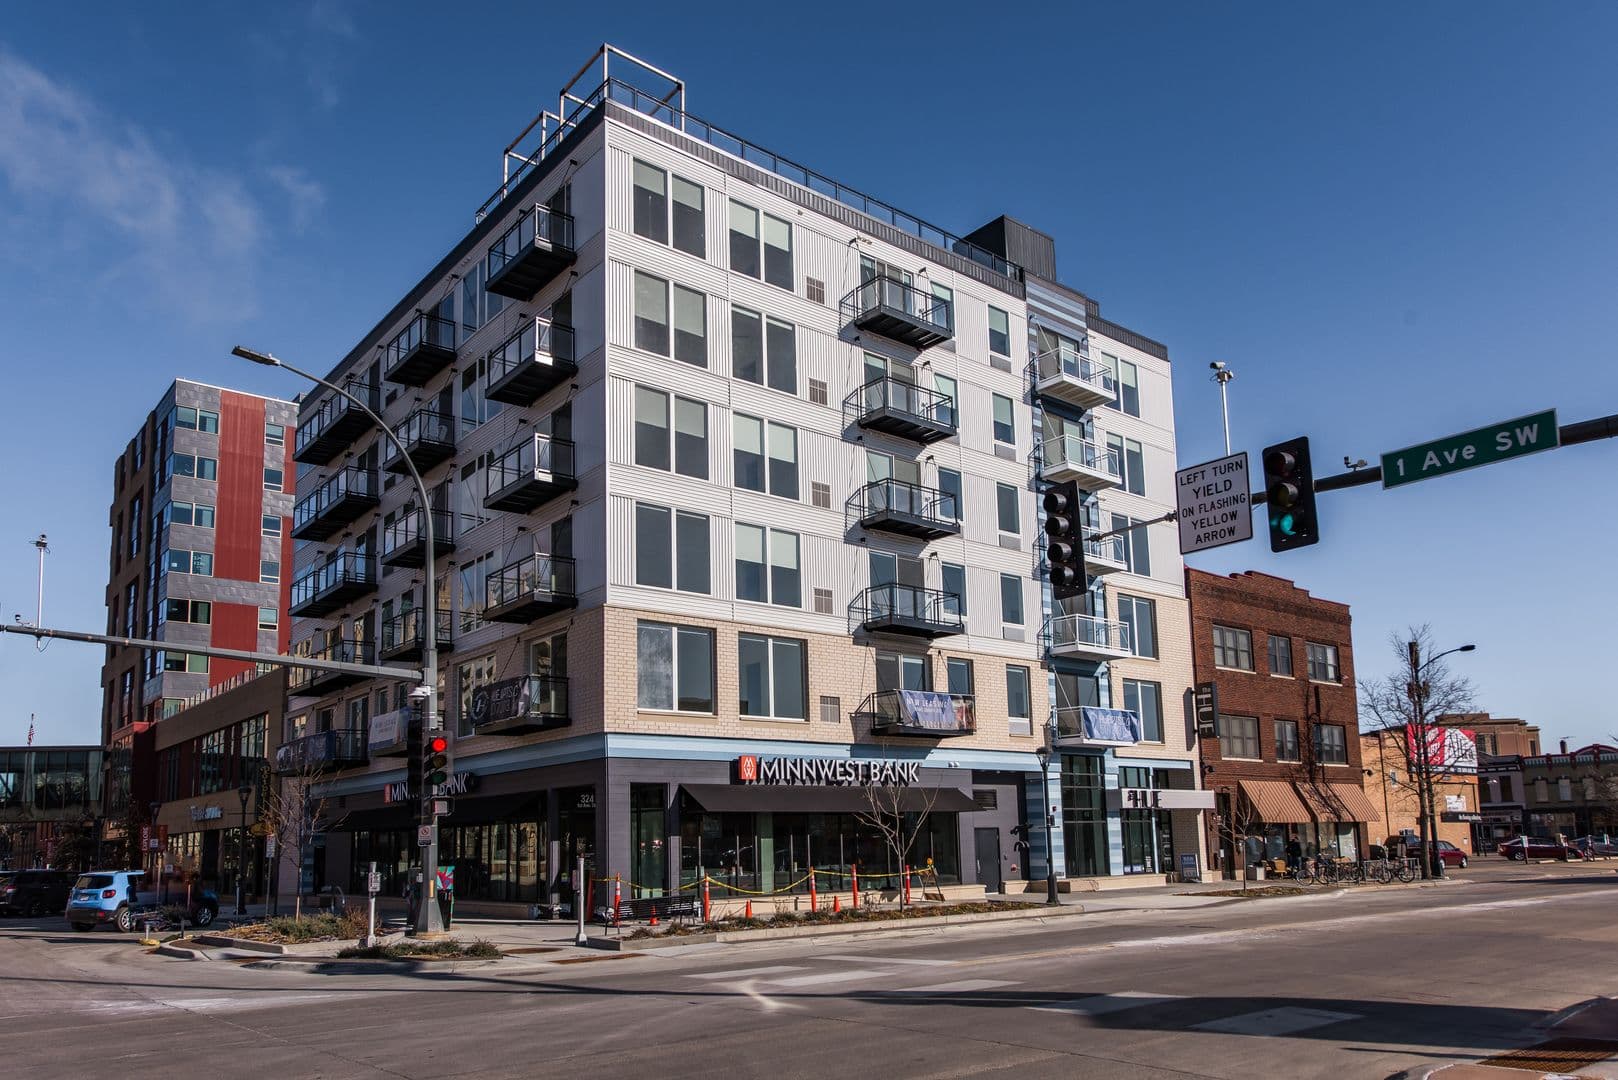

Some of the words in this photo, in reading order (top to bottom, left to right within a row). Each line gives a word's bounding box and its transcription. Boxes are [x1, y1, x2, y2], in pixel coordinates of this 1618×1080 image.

[1396, 457, 1405, 476] 1
[1422, 444, 1476, 471] Ave
[1495, 423, 1539, 451] SW
[1180, 470, 1206, 486] LEFT
[1212, 460, 1243, 477] TURN
[1192, 479, 1232, 500] YIELD
[1181, 506, 1194, 518] ON
[1198, 493, 1246, 514] FLASHING
[1191, 510, 1238, 530] YELLOW
[1195, 526, 1236, 545] ARROW
[1196, 693, 1215, 735] HUE
[759, 757, 867, 782] MINNWEST
[870, 759, 920, 783] BANK
[439, 773, 467, 796] BANK
[580, 794, 594, 804] 324
